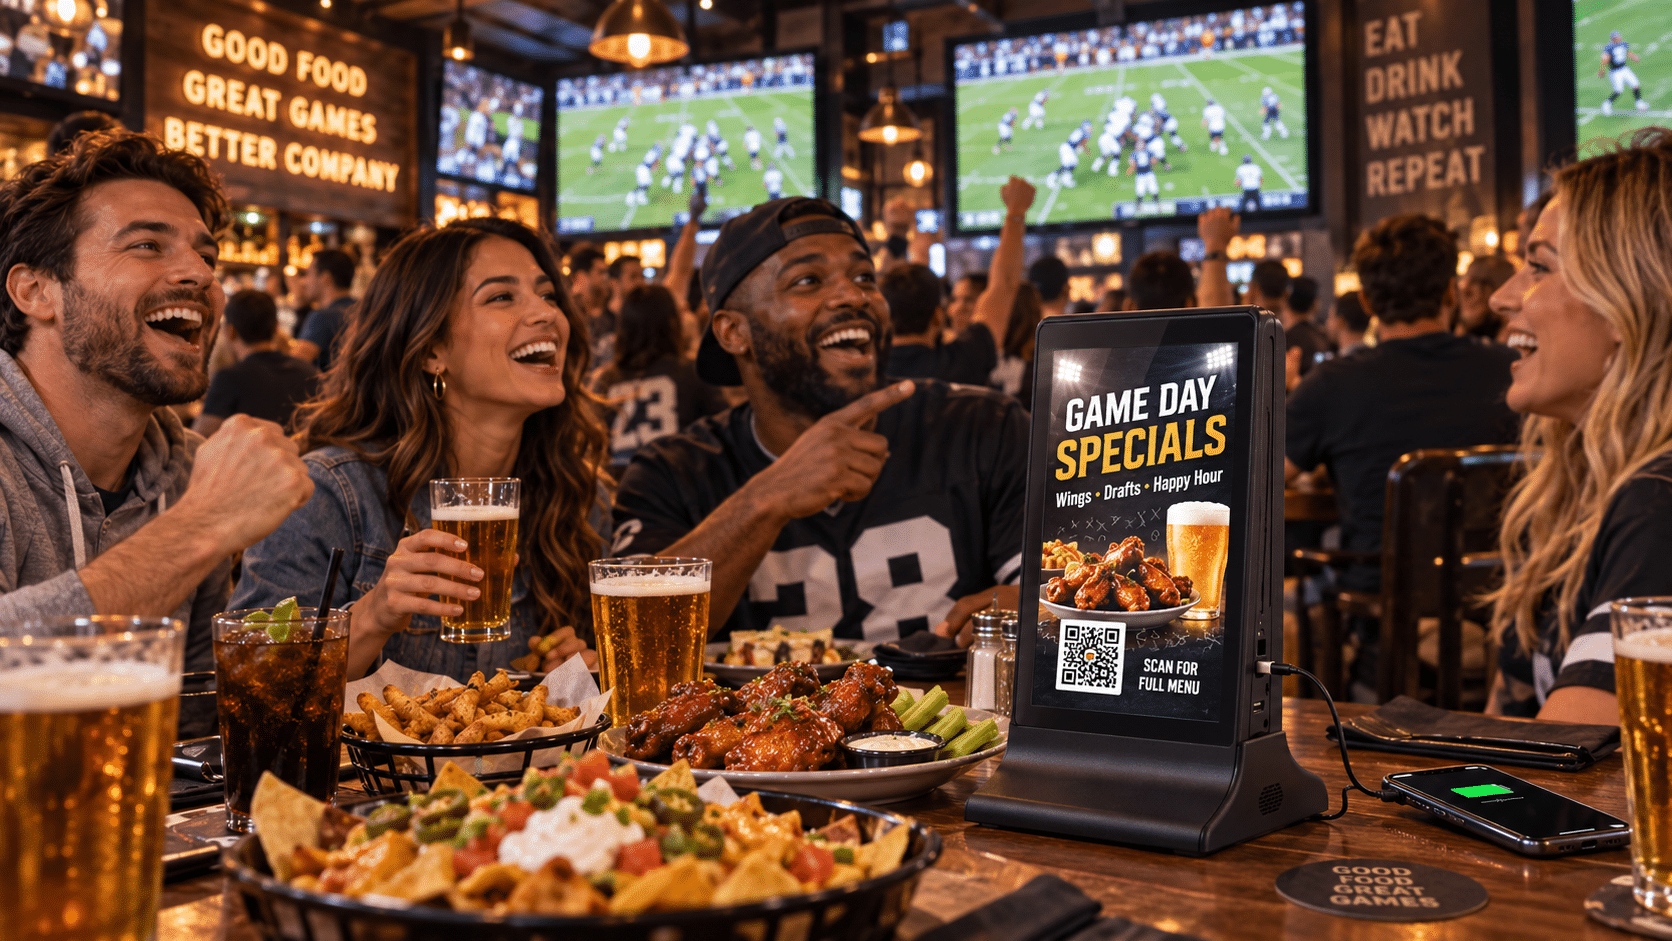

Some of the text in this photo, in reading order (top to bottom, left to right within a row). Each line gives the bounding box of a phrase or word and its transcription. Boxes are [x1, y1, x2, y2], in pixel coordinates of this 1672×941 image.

[1364, 10, 1422, 57] EAT
[202, 23, 367, 97] GOOD FOOD
[1365, 49, 1464, 105] DRINK
[183, 70, 377, 145] GREAT GAMES
[1365, 96, 1475, 150] WATCH
[164, 116, 400, 193] BETTER COMPANY
[1366, 145, 1485, 197] REPEAT
[608, 375, 679, 451] 23
[1065, 374, 1217, 432] GAME DAY
[1055, 414, 1227, 481] SPECIALS
[1056, 469, 1224, 508] Wings Drafts Happy Hour
[1138, 676, 1200, 695] FULL MENU
[1143, 658, 1198, 676] SCAN FOR
[1332, 866, 1411, 875] GOOD
[1333, 884, 1424, 895] GREAT
[1339, 875, 1413, 885] FOOD
[1329, 894, 1440, 908] GAMES
